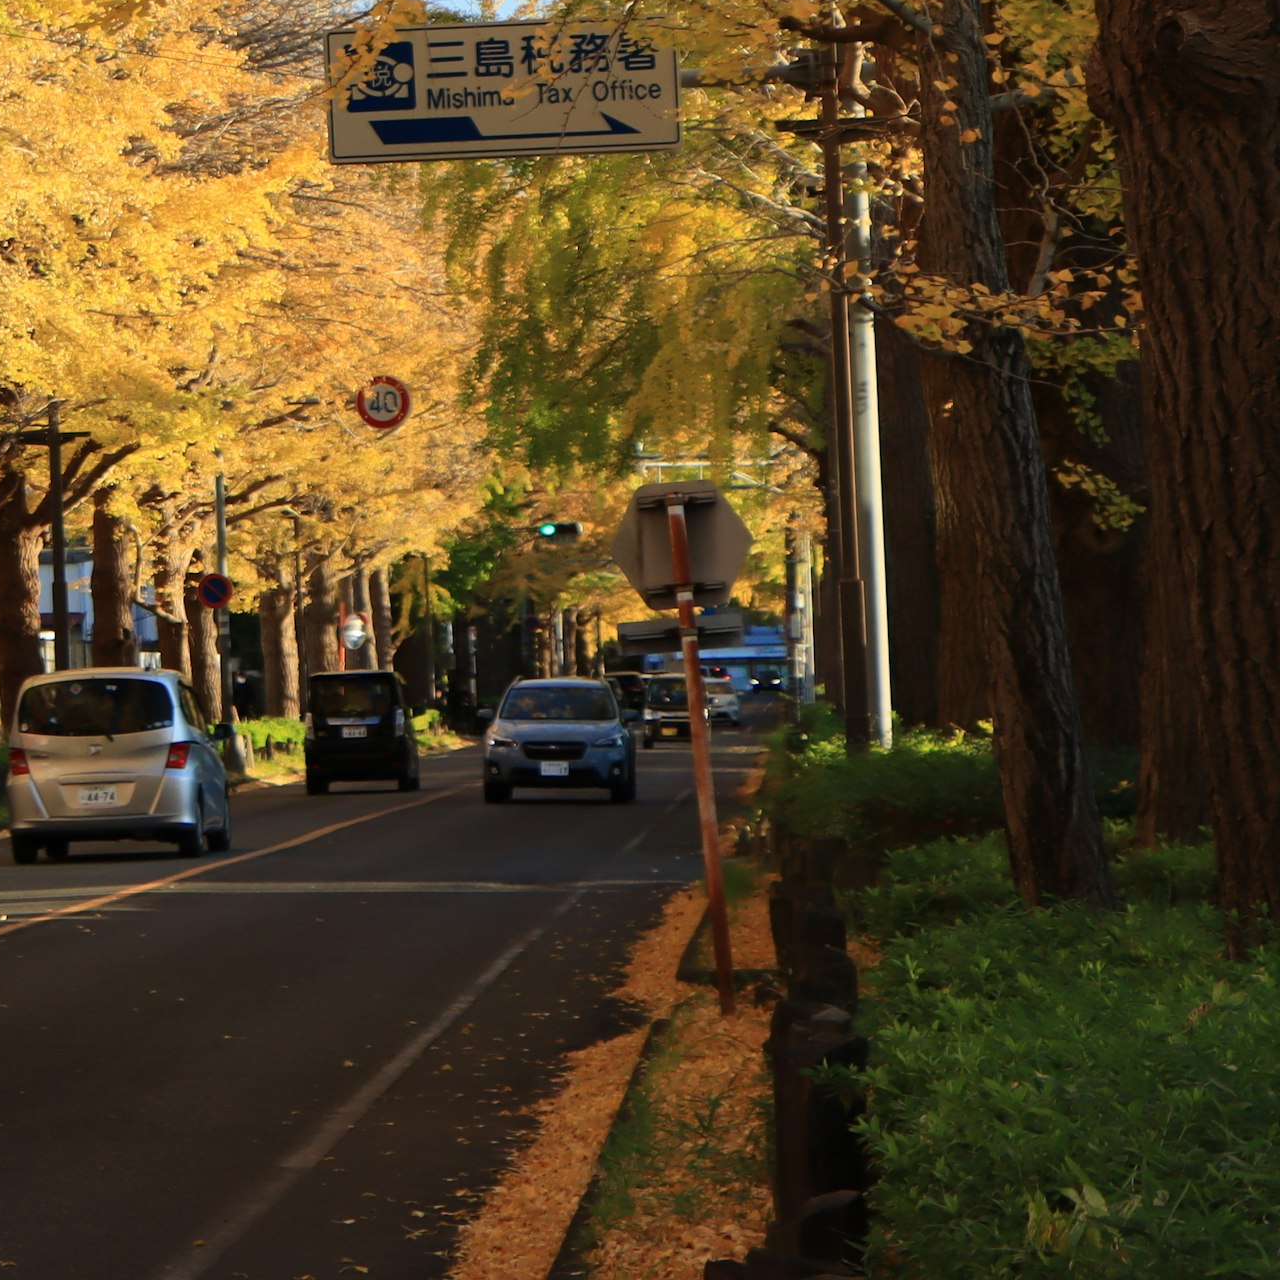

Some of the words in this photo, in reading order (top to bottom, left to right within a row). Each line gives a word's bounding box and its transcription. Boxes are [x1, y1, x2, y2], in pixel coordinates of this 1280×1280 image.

[427, 32, 659, 78] 三島税務署
[536, 82, 574, 105] Tax
[592, 79, 662, 102] Office
[370, 391, 398, 413] 40
